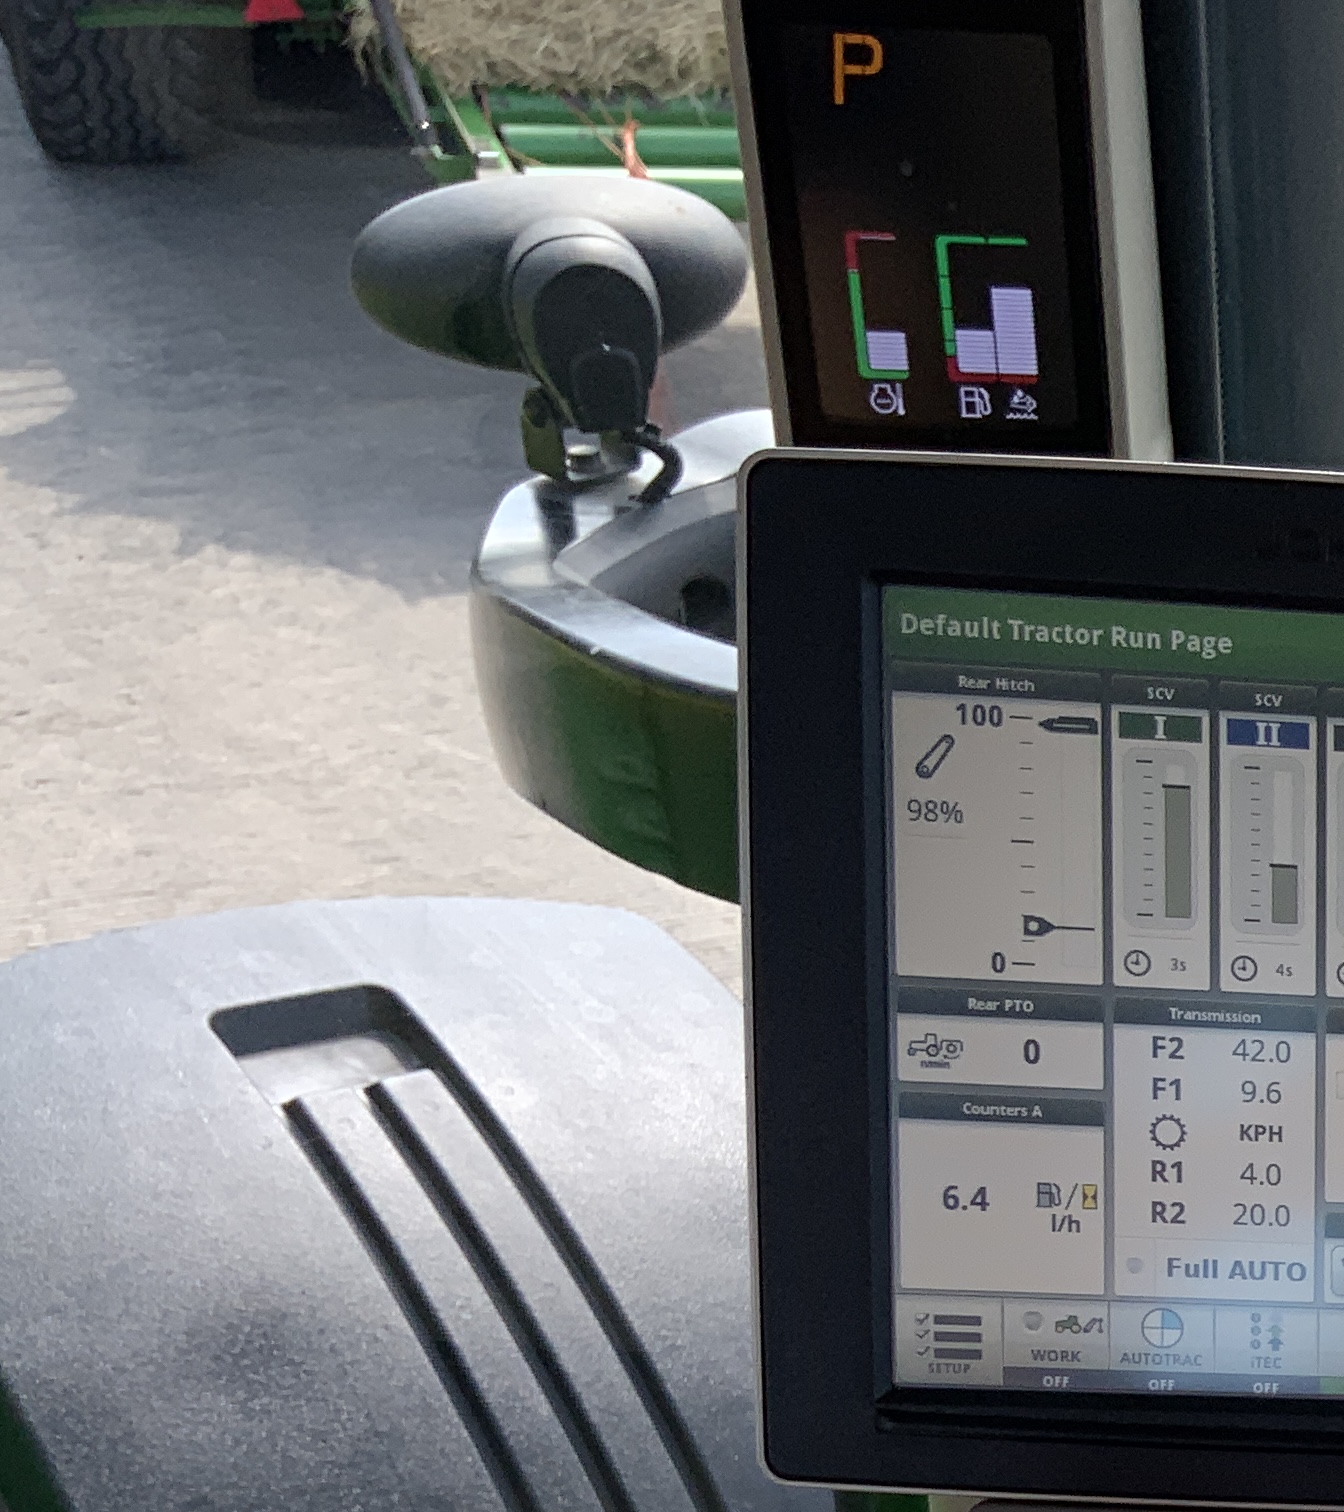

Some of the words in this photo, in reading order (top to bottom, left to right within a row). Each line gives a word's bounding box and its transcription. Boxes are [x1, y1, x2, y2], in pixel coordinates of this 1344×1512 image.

[833, 33, 884, 105] P
[900, 612, 1001, 641] Default
[1007, 616, 1104, 648] Tractor
[1110, 624, 1163, 652] Run
[1170, 629, 1234, 661] Page
[957, 675, 992, 693] Rear
[995, 676, 1036, 695] Hitch
[1146, 685, 1176, 701] SCV
[1254, 692, 1284, 709] SCV
[954, 703, 1003, 728] 100
[1153, 715, 1168, 740] I
[1255, 721, 1282, 747] II
[906, 799, 965, 825] 98%
[991, 951, 1006, 974] 0
[1169, 956, 1188, 974] 3s
[1275, 962, 1294, 979] 4s
[967, 997, 1001, 1014] Rear
[1002, 998, 1034, 1014] PTO
[1168, 1007, 1262, 1027] Transmission
[1023, 1039, 1041, 1065] 0
[1151, 1036, 1185, 1061] F2
[1231, 1040, 1292, 1065] 42.0
[1151, 1076, 1184, 1101] F1
[1240, 1079, 1283, 1105] 9.6
[962, 1101, 1026, 1119] Counters
[1027, 1103, 1044, 1118] A
[1238, 1124, 1284, 1144] KPH
[1150, 1159, 1185, 1184] R1
[1239, 1162, 1282, 1187] 4.0
[942, 1185, 991, 1212] 6.4
[1050, 1213, 1081, 1235] l/h
[1150, 1200, 1186, 1226] R2
[1232, 1203, 1292, 1228] 20.0
[1166, 1256, 1220, 1281] Full
[1227, 1258, 1308, 1283] AUTO
[1030, 1347, 1082, 1365] WORK
[1119, 1350, 1204, 1368] AUTOTRAC
[1250, 1355, 1283, 1371] iTEC
[927, 1361, 972, 1376] SETUP
[1042, 1374, 1070, 1390] OFF
[1147, 1377, 1175, 1393] OFF
[1252, 1380, 1280, 1396] OFF
